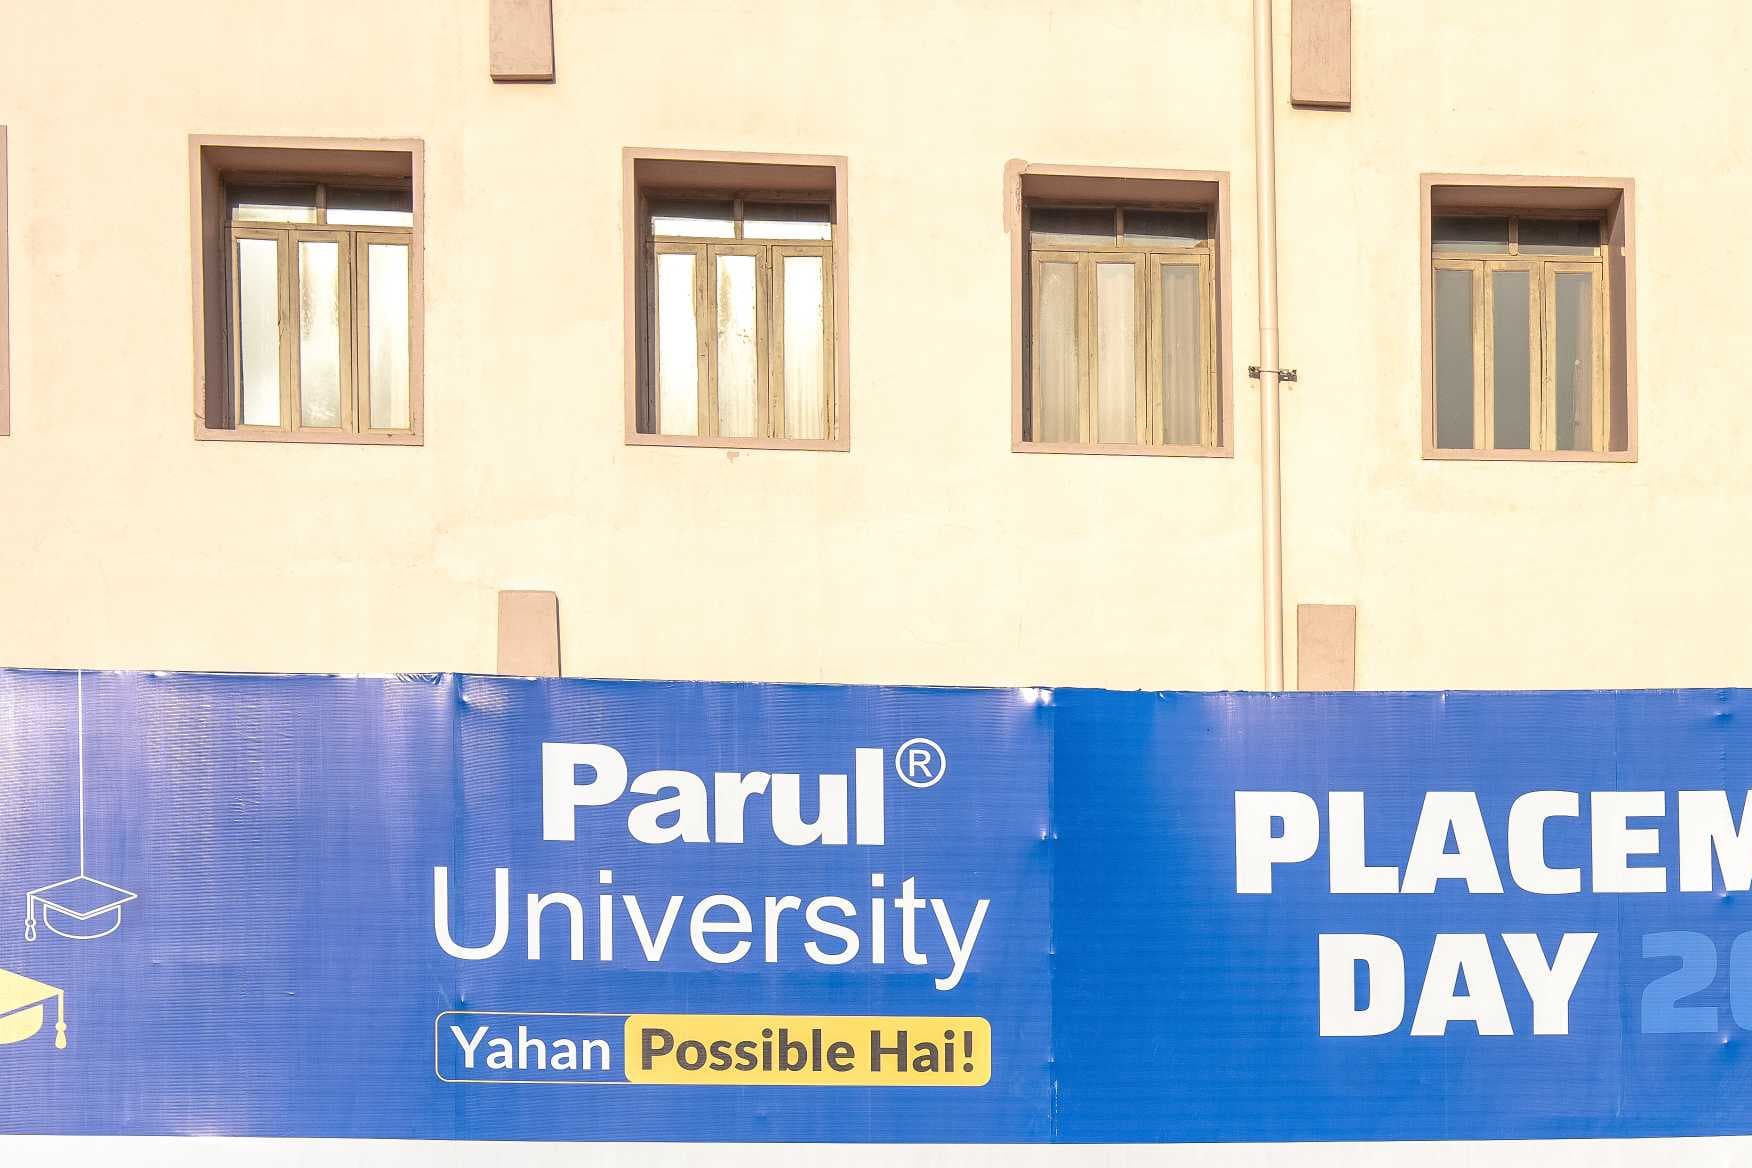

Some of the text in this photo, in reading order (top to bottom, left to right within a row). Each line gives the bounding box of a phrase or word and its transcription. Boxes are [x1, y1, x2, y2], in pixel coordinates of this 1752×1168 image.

[433, 866, 990, 990] University
[1318, 932, 1598, 1036] DAY
[450, 1026, 974, 1073] Yahan Possible Hai!
